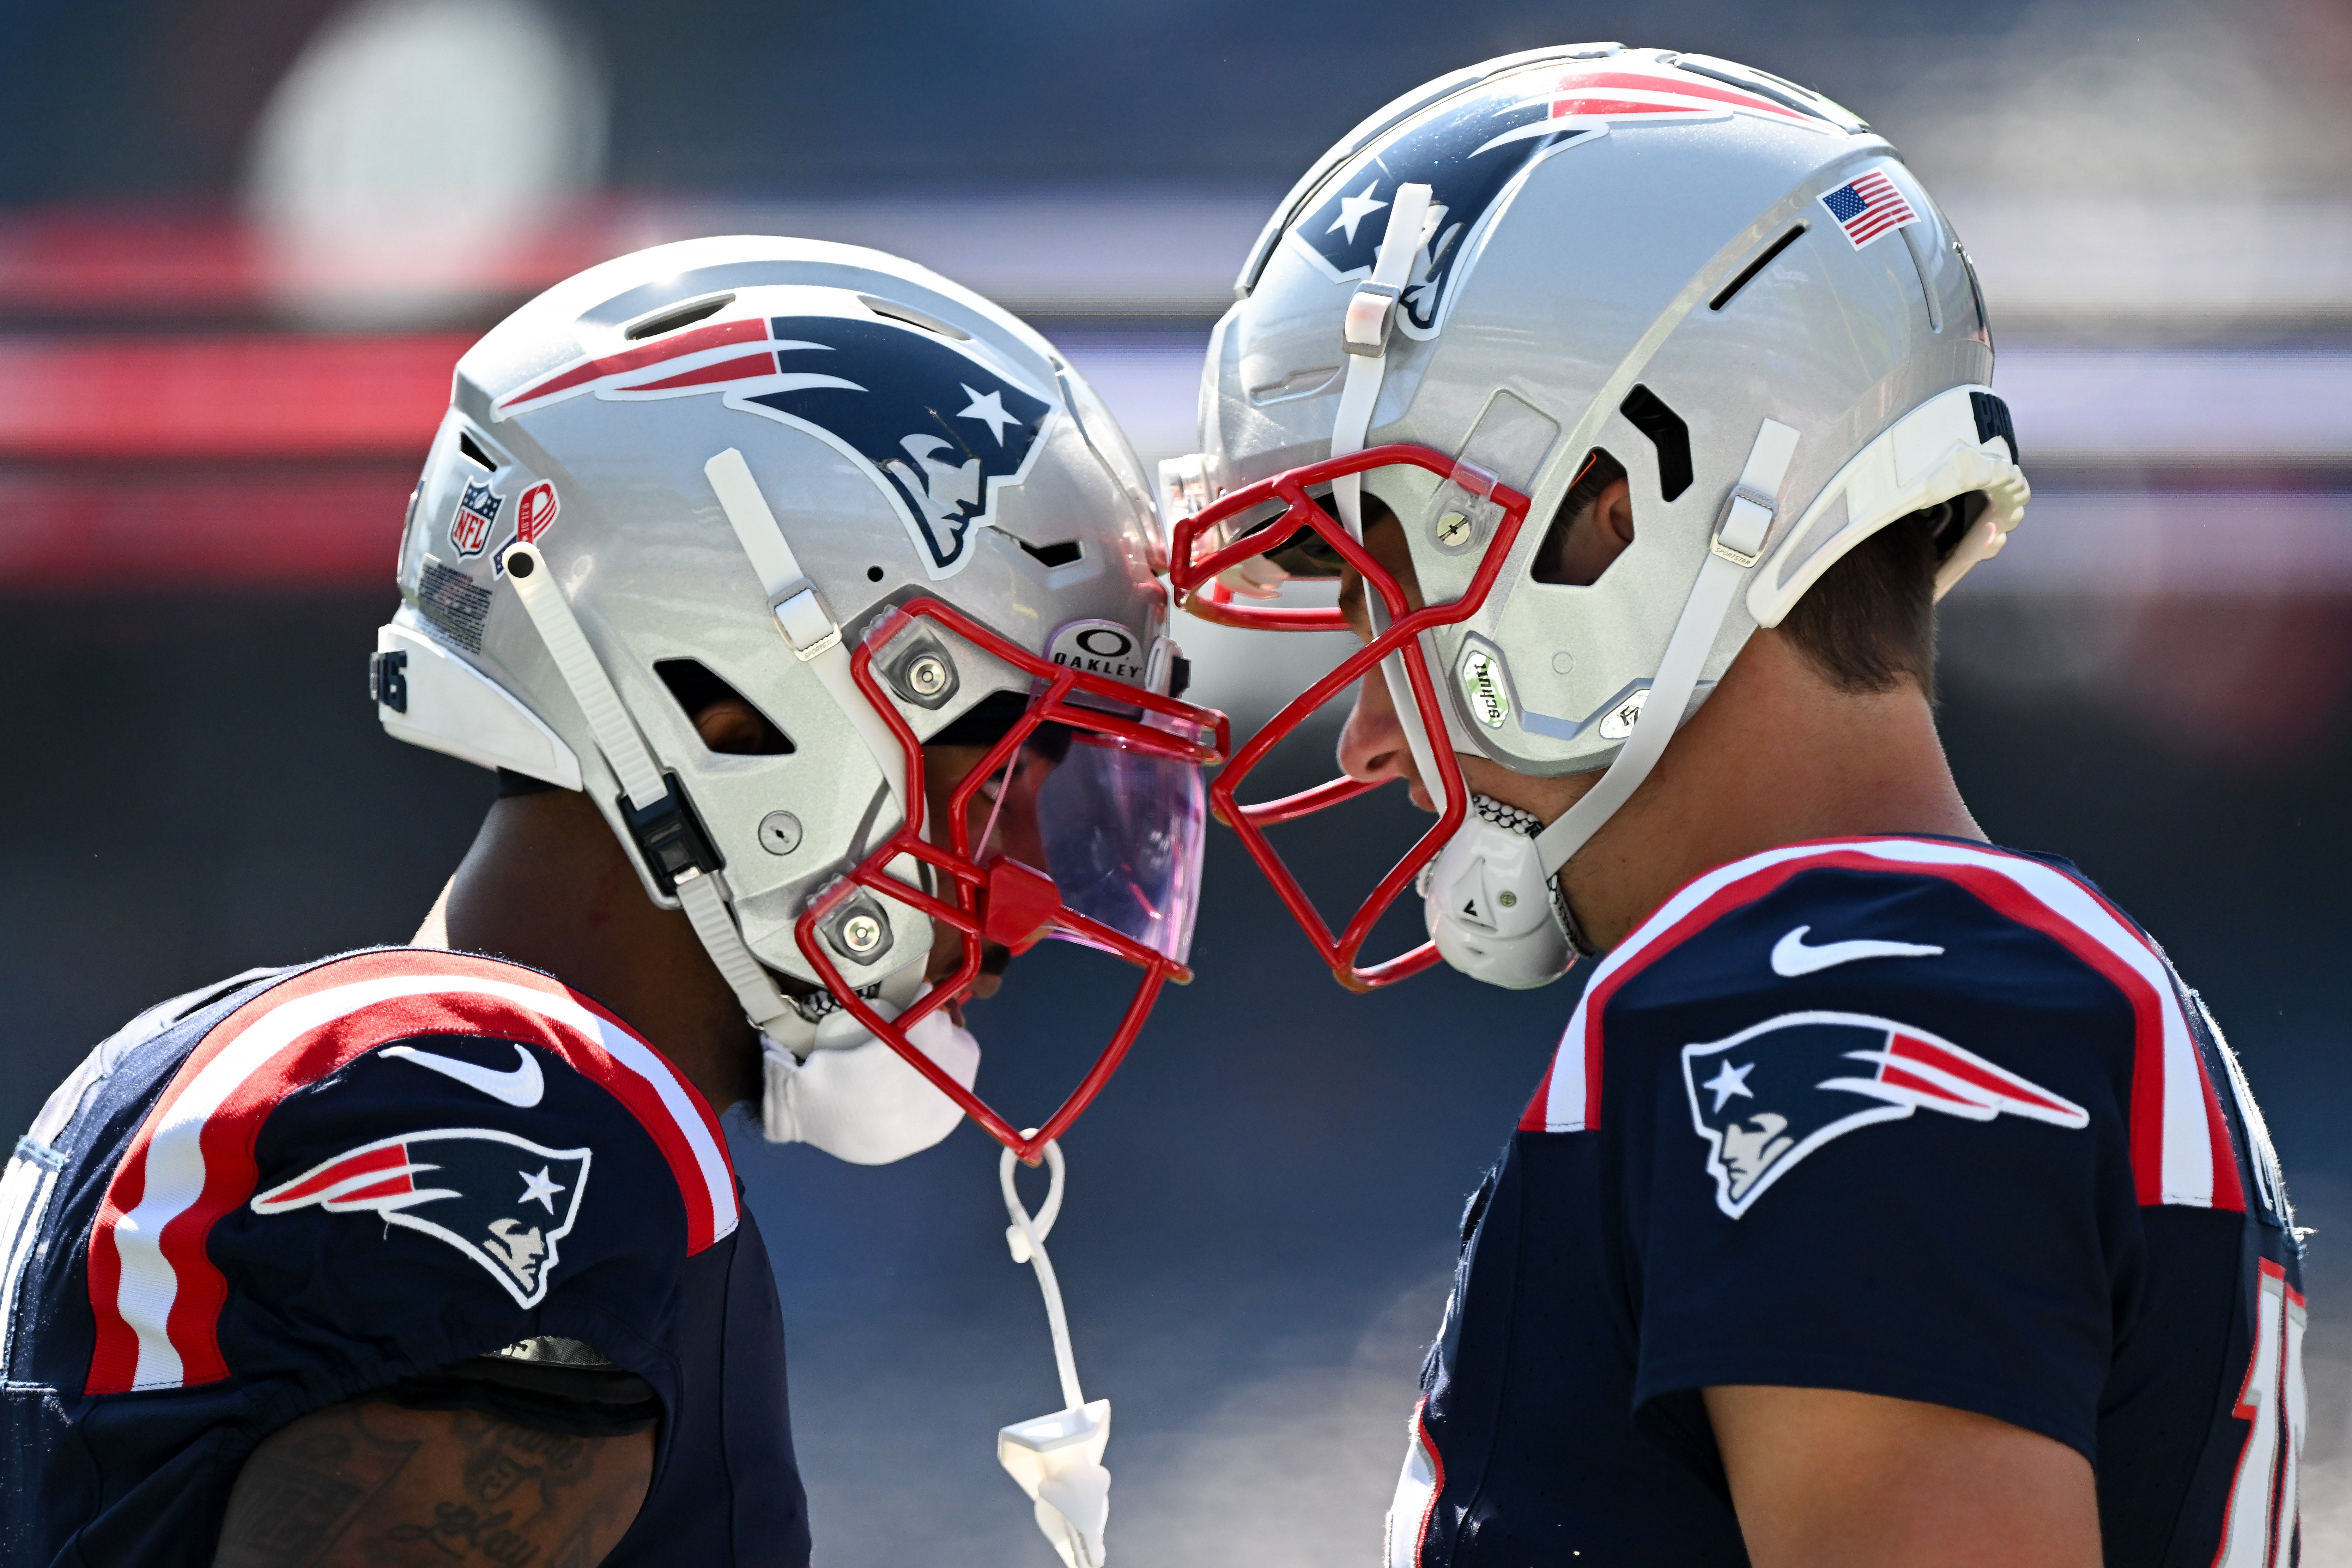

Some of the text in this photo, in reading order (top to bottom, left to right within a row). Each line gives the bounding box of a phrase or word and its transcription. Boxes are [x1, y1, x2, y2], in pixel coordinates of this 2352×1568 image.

[454, 509, 485, 549] NFL
[1715, 547, 1751, 565] SPORTSTAR
[1053, 652, 1139, 678] OAKLEY
